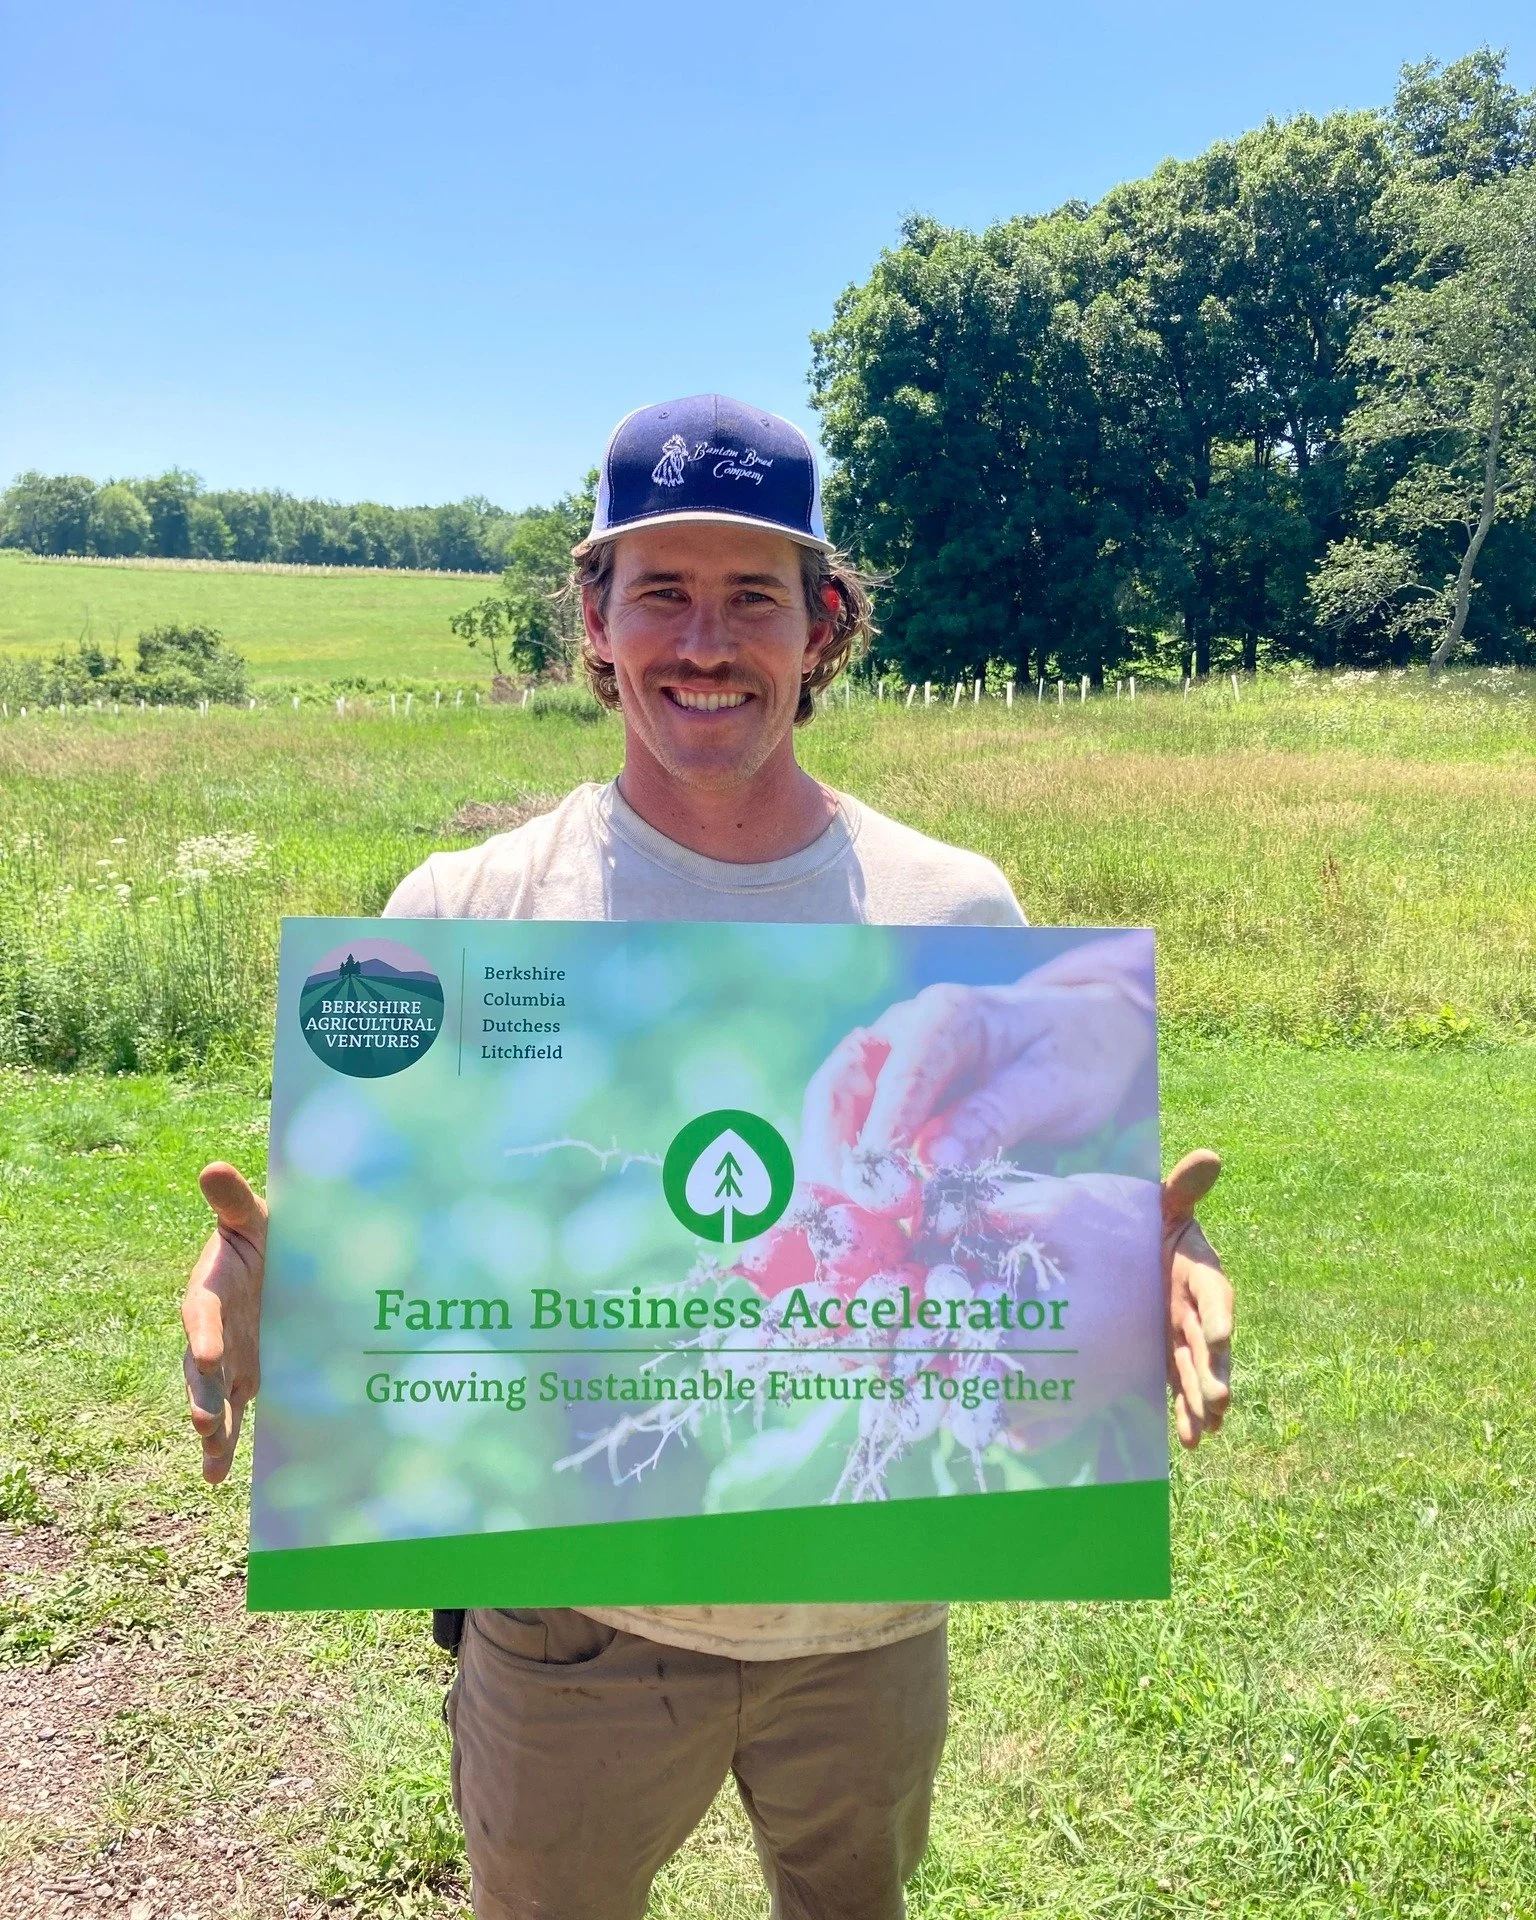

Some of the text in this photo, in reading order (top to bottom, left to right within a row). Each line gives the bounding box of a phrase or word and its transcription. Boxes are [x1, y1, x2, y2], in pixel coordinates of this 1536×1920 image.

[688, 441, 738, 461] Bantam
[713, 460, 763, 485] Company
[484, 966, 566, 981] Berkshire
[483, 992, 566, 1007] Columbia
[321, 1000, 422, 1015] BERKSHIRE
[305, 1017, 436, 1032] AGRICULTURAL
[482, 1018, 561, 1033] Dutchess
[325, 1034, 420, 1049] VENTURES
[481, 1044, 563, 1060] Litchfield
[373, 1286, 1069, 1331] Farm Business Accelerator
[366, 1370, 1075, 1412] Growing Sustainable Futures Together
